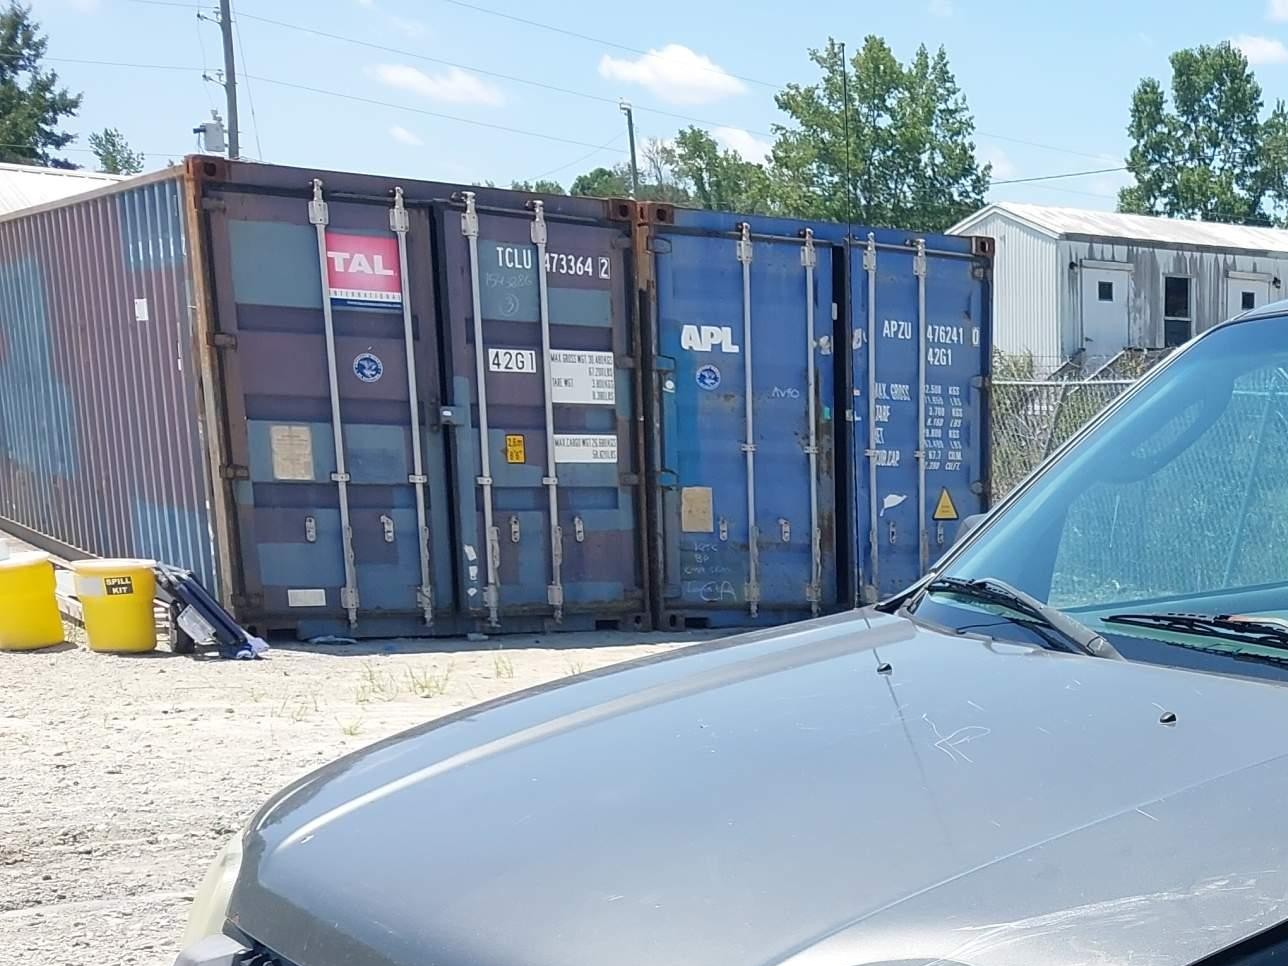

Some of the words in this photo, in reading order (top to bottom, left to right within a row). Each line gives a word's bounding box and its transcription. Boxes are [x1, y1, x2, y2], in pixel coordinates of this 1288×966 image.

[327, 251, 394, 276] TAL
[496, 247, 532, 269] TCLU
[544, 253, 593, 276] 473364
[600, 259, 609, 277] 2
[681, 325, 740, 353] APL
[882, 320, 912, 339] APZU
[926, 325, 964, 345] 476241
[972, 328, 980, 345] 0
[492, 350, 535, 371] 42G1
[927, 347, 952, 366] 42G1
[105, 577, 131, 586] SPILL
[112, 586, 129, 594] KIT
